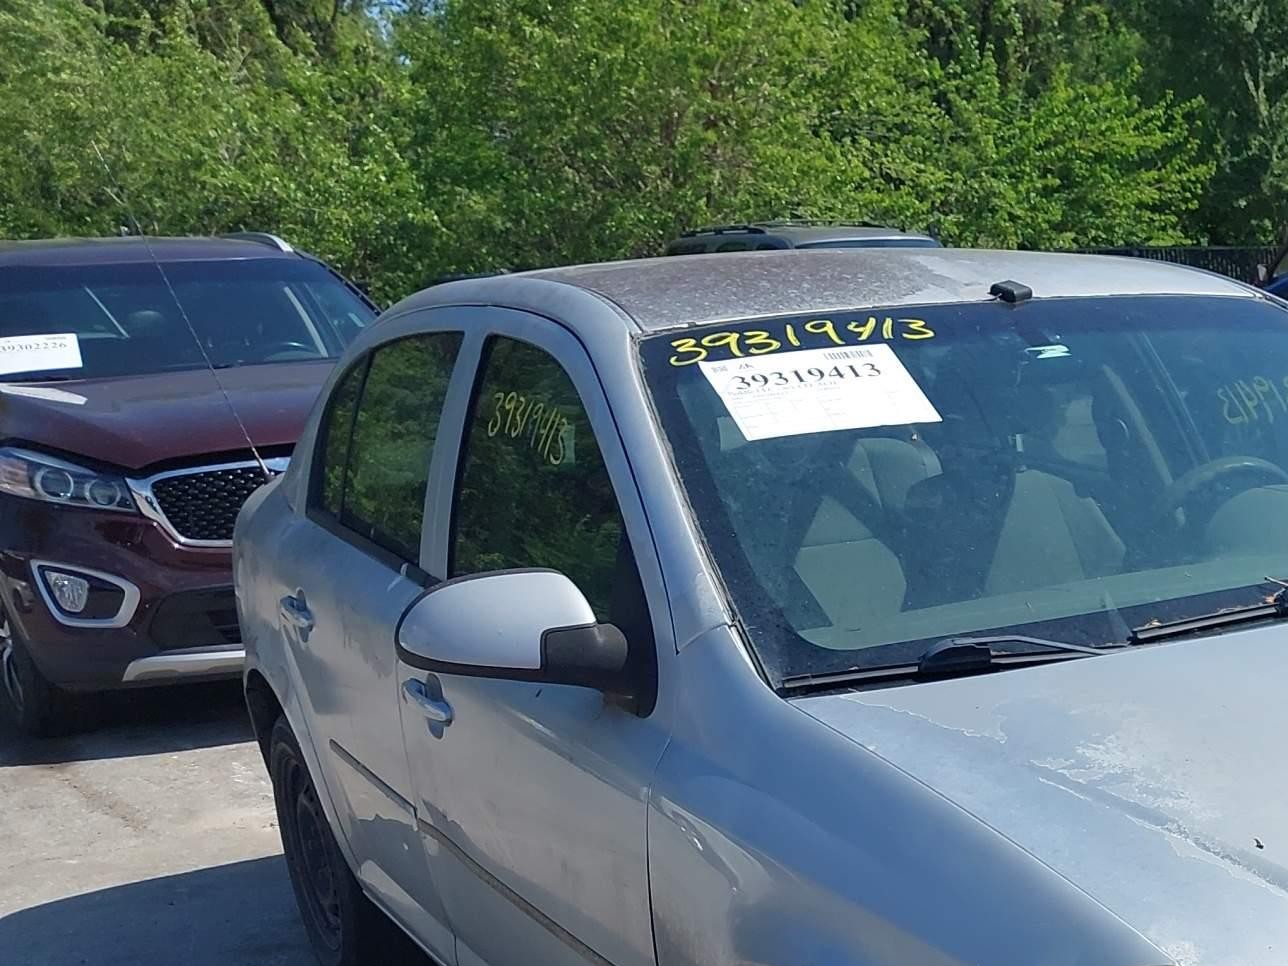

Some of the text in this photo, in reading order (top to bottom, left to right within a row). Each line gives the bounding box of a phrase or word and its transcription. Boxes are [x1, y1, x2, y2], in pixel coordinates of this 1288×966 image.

[669, 317, 936, 367] 39319413
[731, 362, 882, 391] 39319413
[488, 391, 568, 465] 39319413
